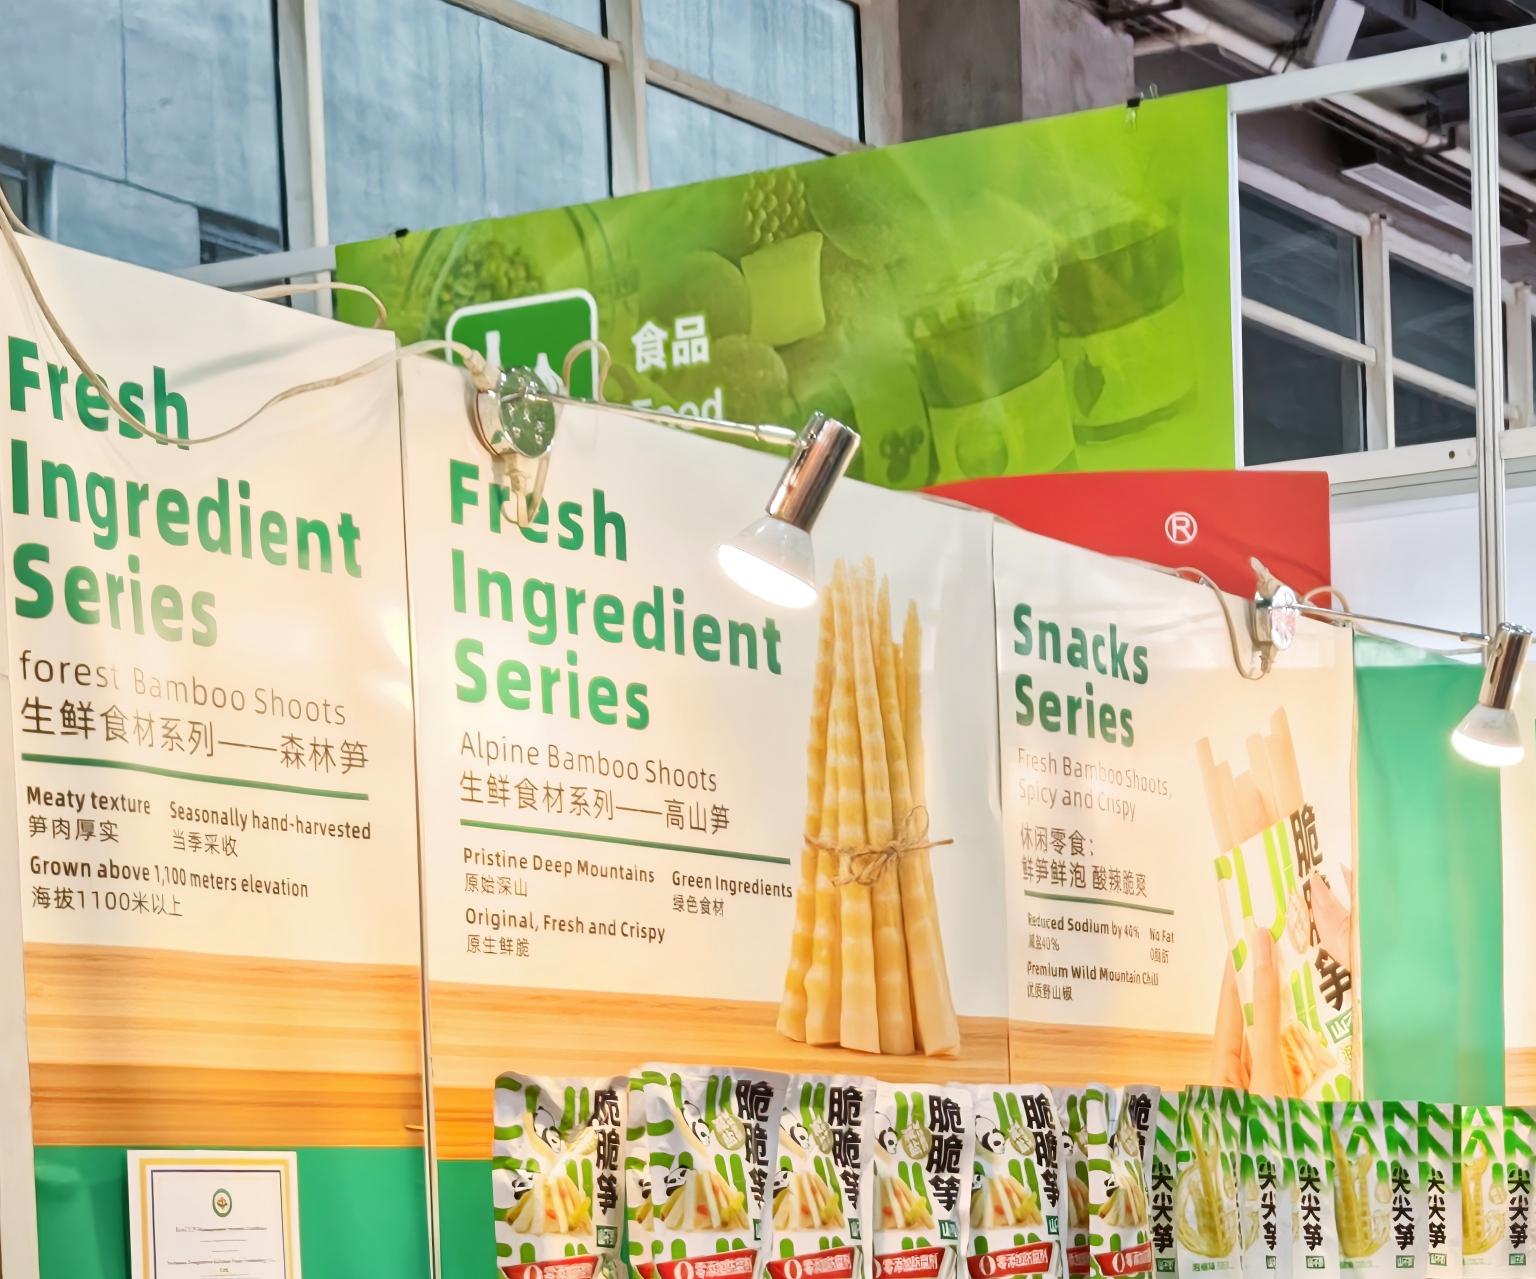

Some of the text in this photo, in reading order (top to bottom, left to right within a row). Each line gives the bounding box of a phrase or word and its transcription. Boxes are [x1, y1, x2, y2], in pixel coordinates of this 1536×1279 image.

[631, 315, 710, 373] 食品
[8, 335, 190, 450] Fresh
[11, 439, 363, 578] Ingredient
[449, 458, 628, 562] Fresh
[13, 542, 218, 648] Series
[451, 548, 782, 675] Ingredient
[1013, 602, 1149, 685] Snacks
[19, 650, 347, 726] forest Bamboo Shoots
[454, 637, 650, 731] Series
[1015, 673, 1135, 748] Series
[460, 730, 717, 793] Alpine Bamboo Shoots
[1018, 747, 1057, 776] Fresh
[1063, 755, 1123, 788] Bamboo
[27, 786, 152, 815] Meaty texture
[29, 815, 120, 844] 笋肉厚实
[169, 801, 372, 840] Seasonally hand-harvested
[1019, 779, 1136, 823] Spicy and Crispy
[171, 829, 239, 858] 当季采收
[463, 847, 655, 884] Pristine Deep Mountains
[30, 855, 309, 899] Grown above 1,100 meters elevation
[31, 885, 183, 918] 海拔1100米以上
[463, 872, 528, 898] 原始深山
[672, 870, 793, 899] Green Ingredients
[465, 907, 665, 944] Original, Fresh and Crispy
[466, 933, 530, 958] 原生鲜脆
[1027, 912, 1065, 931] Reduced
[1067, 918, 1110, 935] Sodium
[1111, 921, 1122, 939] by
[1150, 927, 1175, 943] No Fat
[1027, 960, 1068, 979] Premium
[1071, 965, 1097, 980] Wild
[1099, 967, 1141, 984] Mountain
[828, 1086, 863, 1210] 脆脆笋
[926, 1095, 965, 1211] 脆脆笋
[1021, 1093, 1059, 1208] 脆脆笋
[1152, 1163, 1174, 1254] 尖尖笋
[1299, 1164, 1323, 1251] 尖尖笋
[1392, 1166, 1415, 1250] 尖尖笋
[1508, 1168, 1531, 1248] 尖尖笋
